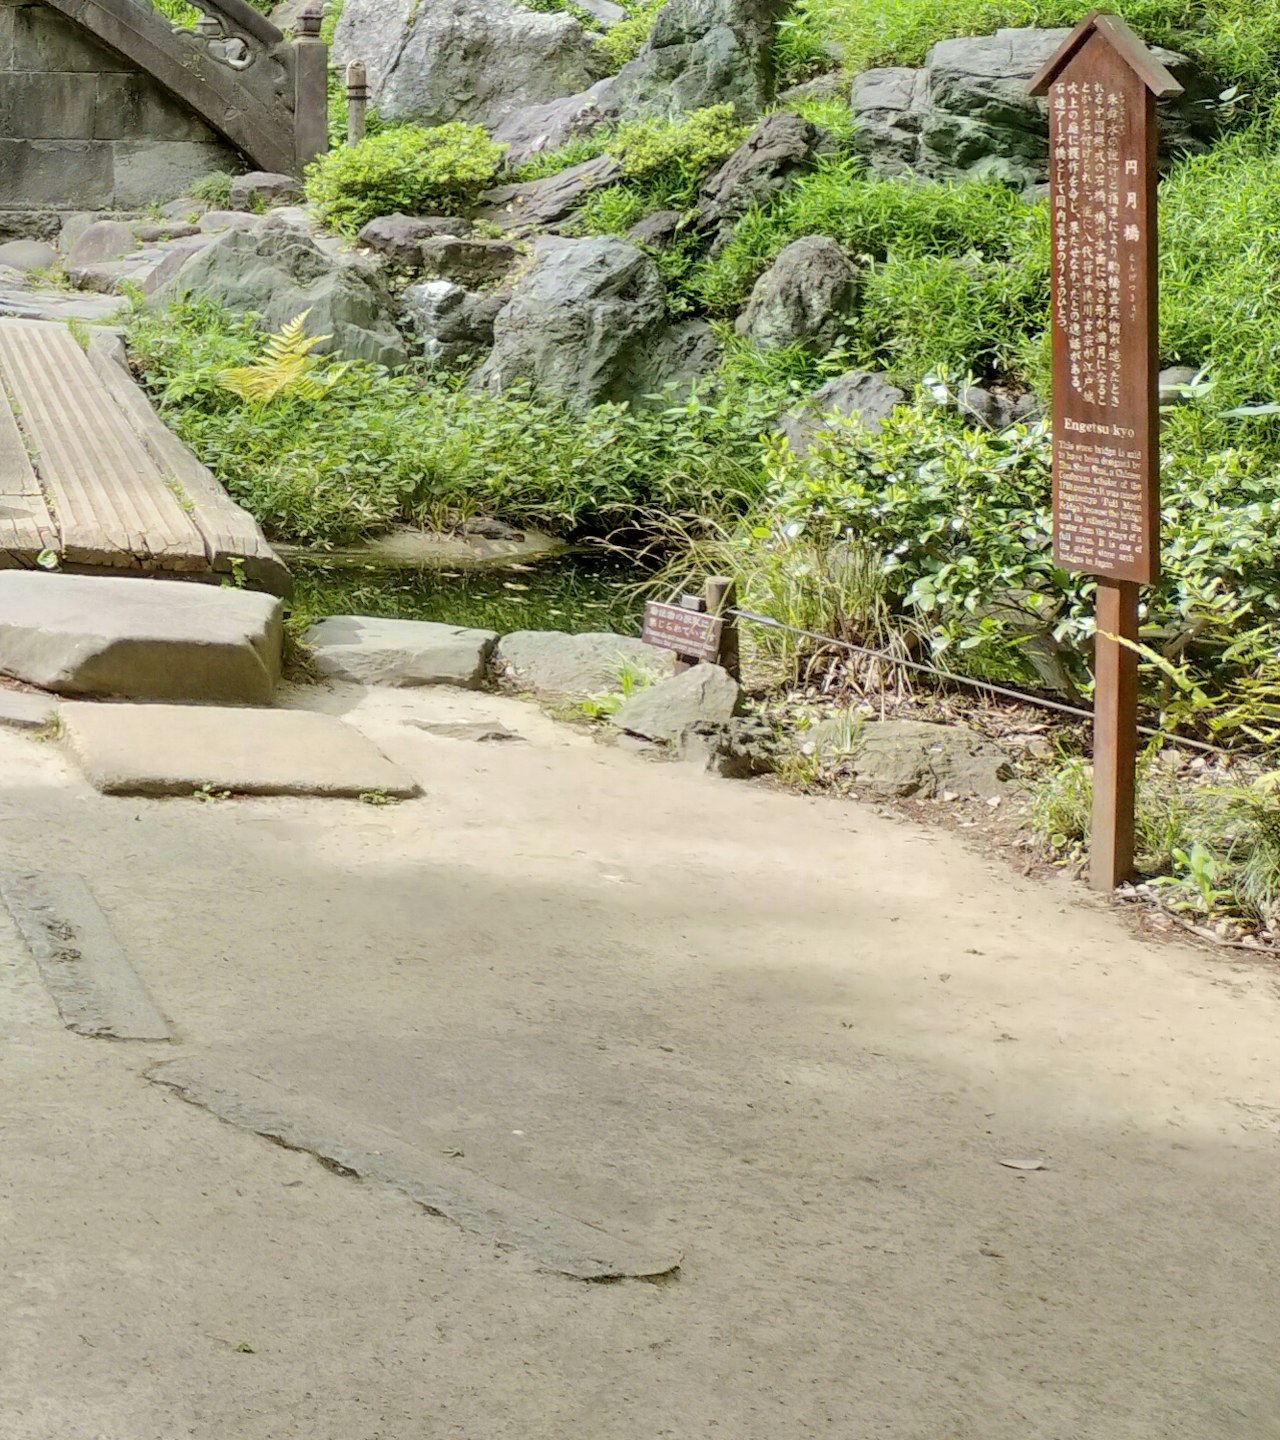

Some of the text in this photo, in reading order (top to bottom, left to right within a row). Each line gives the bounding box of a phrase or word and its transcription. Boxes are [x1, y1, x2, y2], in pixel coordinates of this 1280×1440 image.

[1123, 159, 1140, 242] 円月橋
[1058, 440, 1074, 450] This
[1076, 443, 1093, 452] stone
[1095, 445, 1116, 456] bridge
[1127, 451, 1141, 459] said
[1066, 452, 1082, 461] have
[1084, 454, 1099, 463] been
[1101, 456, 1130, 468] designed
[1059, 471, 1090, 483] Confucian
[1094, 478, 1117, 487] scholar
[1115, 469, 1141, 480] Chinese
[1106, 490, 1119, 498] was
[1120, 491, 1142, 500] named
[1083, 506, 1107, 515] because
[1121, 511, 1142, 522] bridge
[1123, 501, 1141, 511] Moon
[1059, 513, 1071, 521] and
[1086, 517, 1117, 528] reflection
[1059, 523, 1077, 531] water
[1109, 530, 1127, 540] shape
[1059, 552, 1083, 563] bridges
[1074, 545, 1093, 555] oldest
[1098, 550, 1115, 559] stone
[1119, 554, 1134, 562] arch
